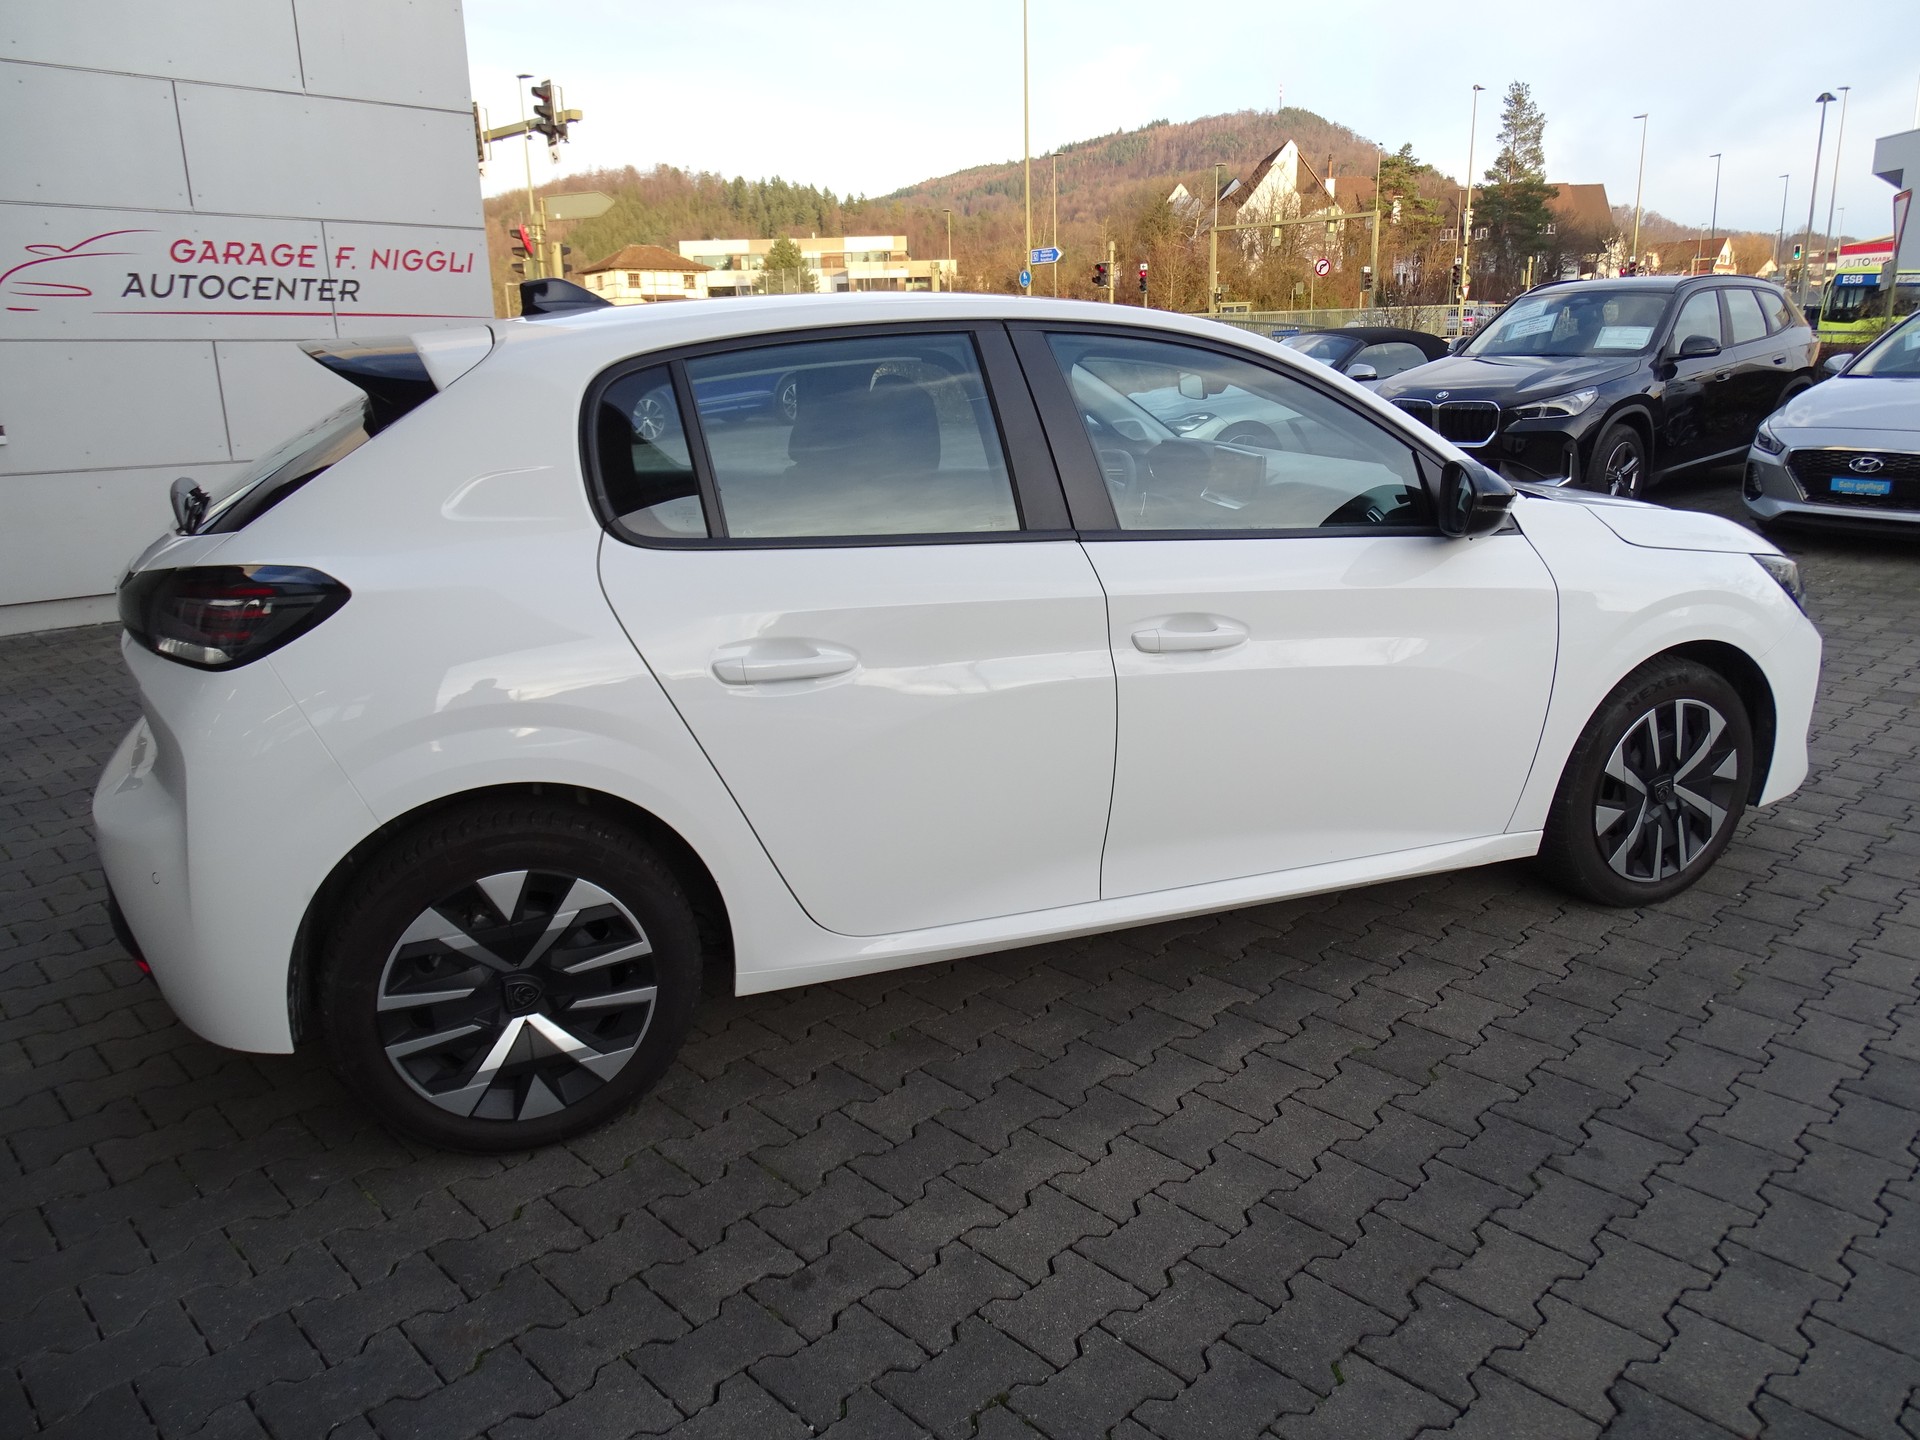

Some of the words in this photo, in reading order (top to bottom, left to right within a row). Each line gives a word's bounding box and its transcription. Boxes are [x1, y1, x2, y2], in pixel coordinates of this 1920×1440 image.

[170, 239, 318, 268] GARAGE
[335, 247, 356, 270] F.
[370, 249, 474, 273] NIGGLI
[1840, 258, 1870, 268] AUTO
[121, 273, 361, 302] AUTOCENTER
[1842, 275, 1864, 284] ESB
[1625, 674, 1689, 711] NEXEN
